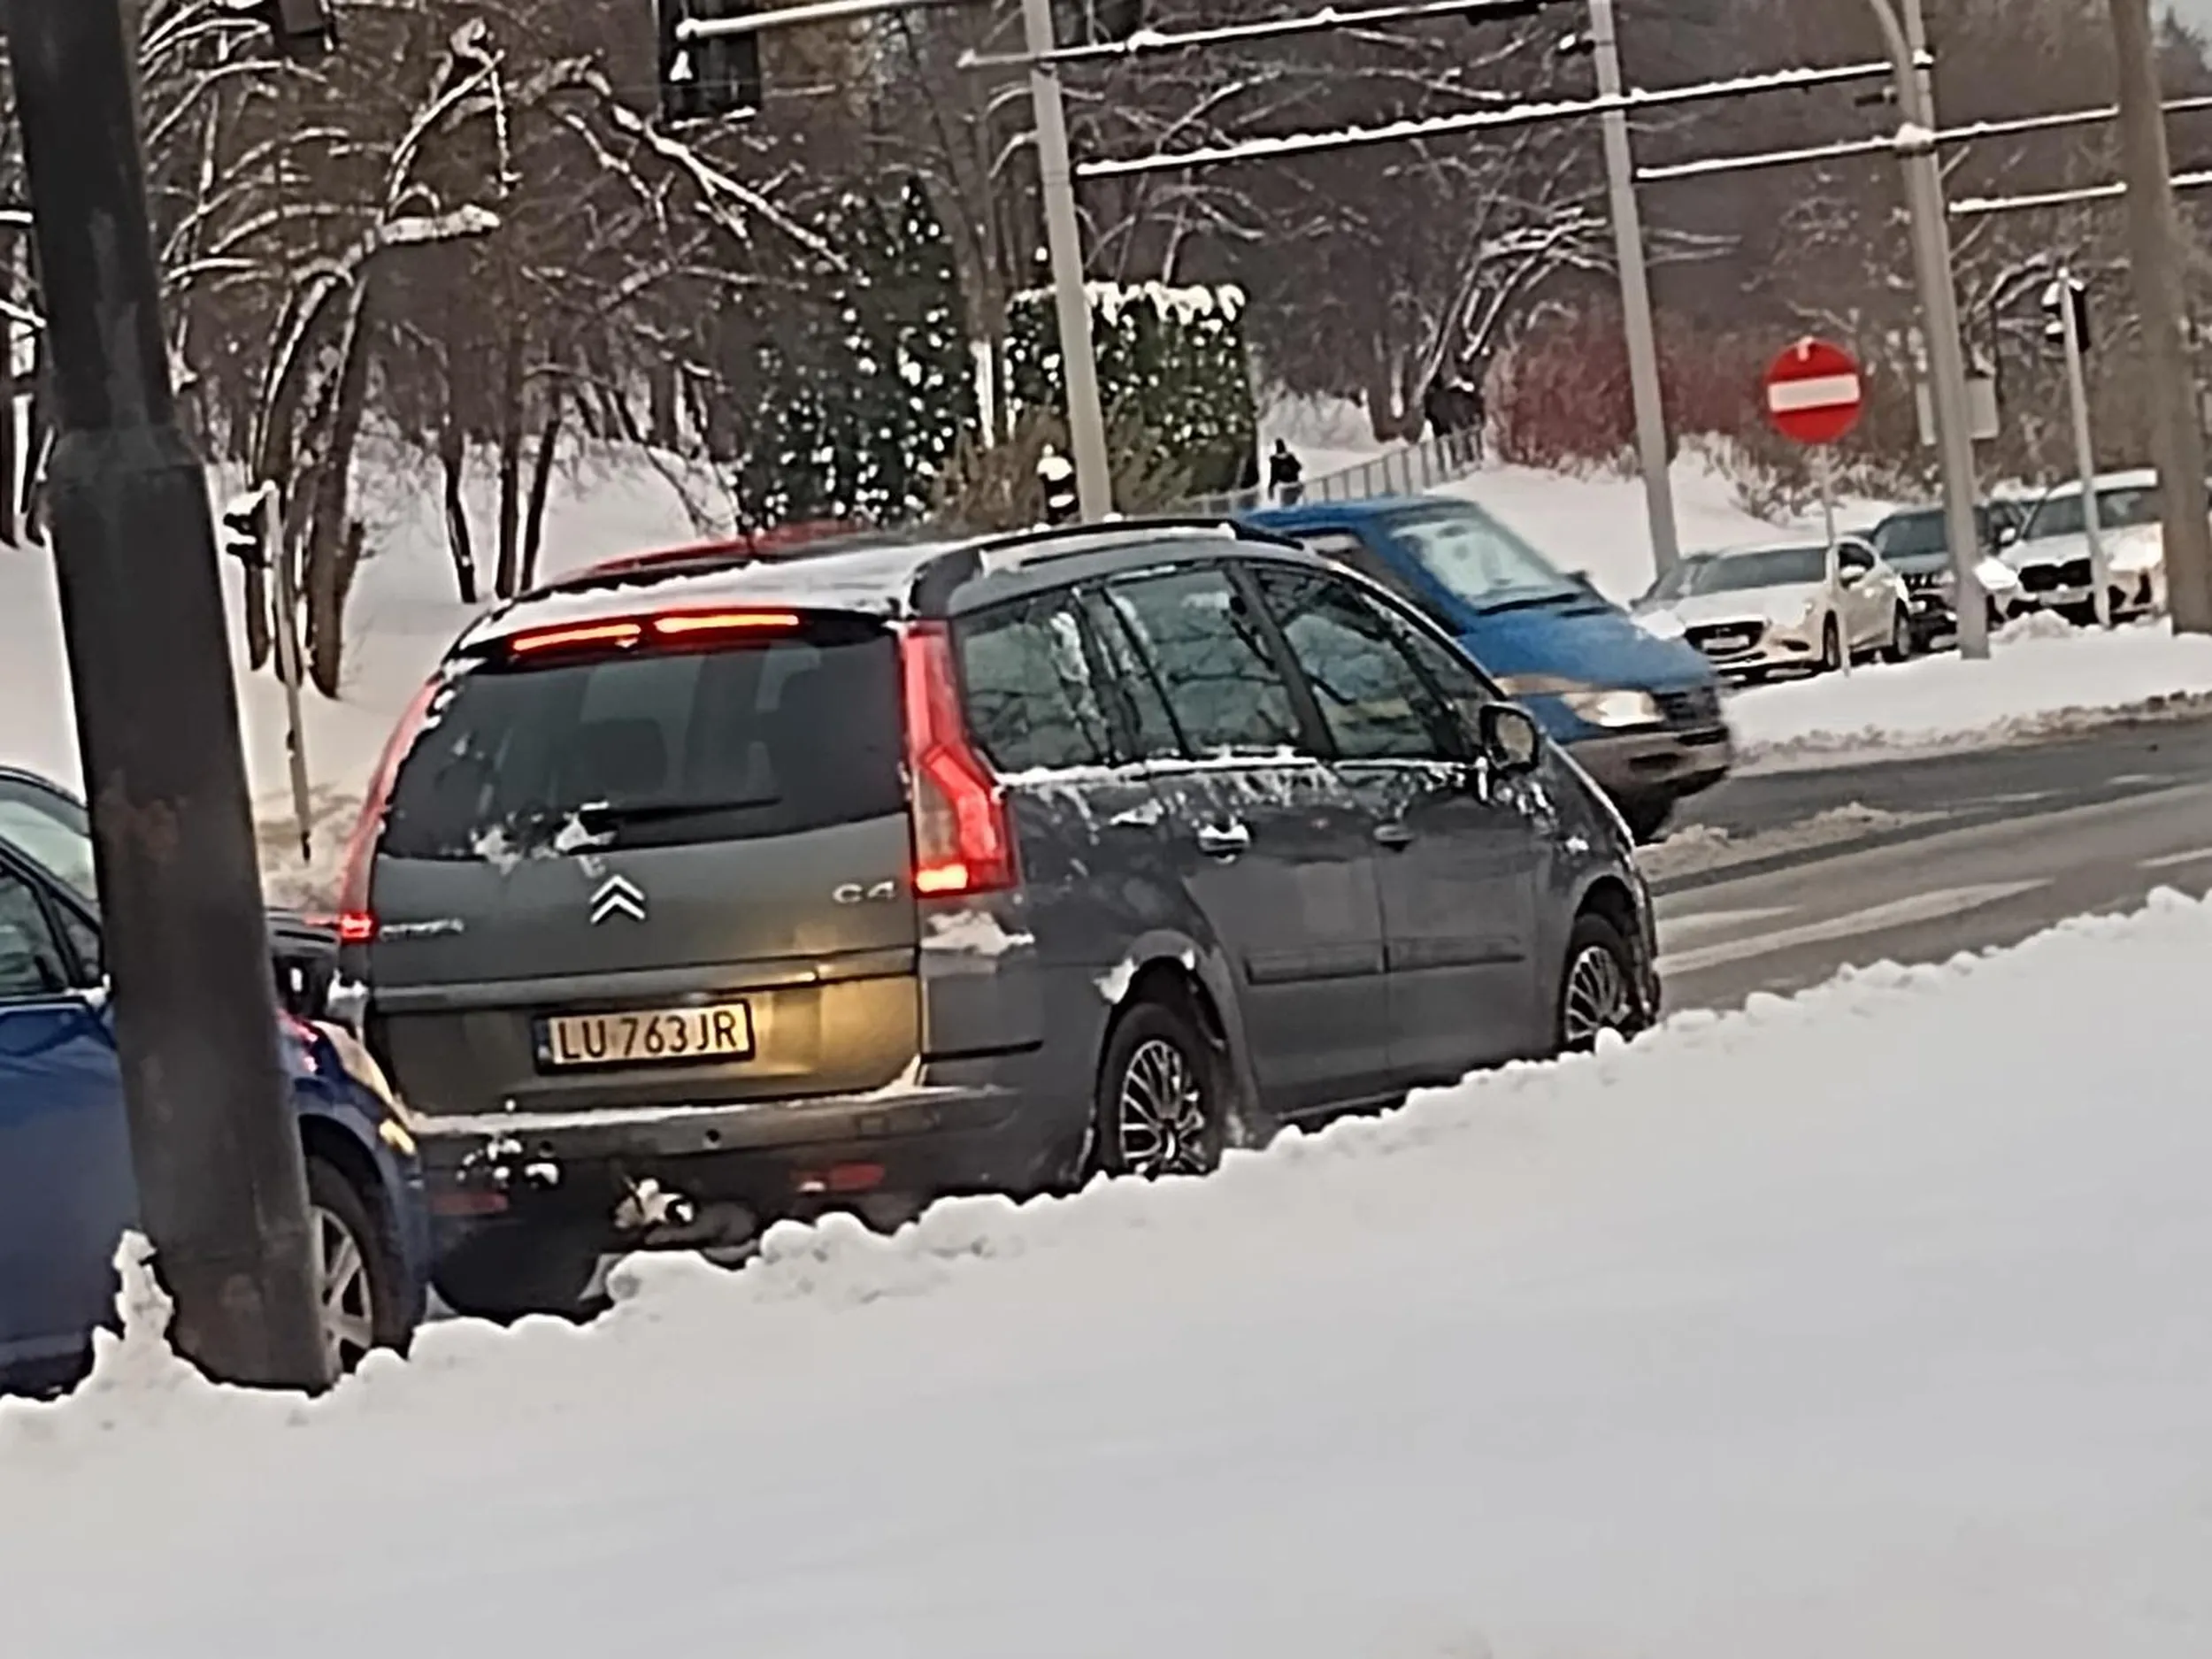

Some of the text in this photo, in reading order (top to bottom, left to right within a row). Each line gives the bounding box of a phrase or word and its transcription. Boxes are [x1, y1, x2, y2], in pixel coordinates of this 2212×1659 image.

[833, 881, 895, 903] C4
[557, 1010, 737, 1059] LU 763JR
